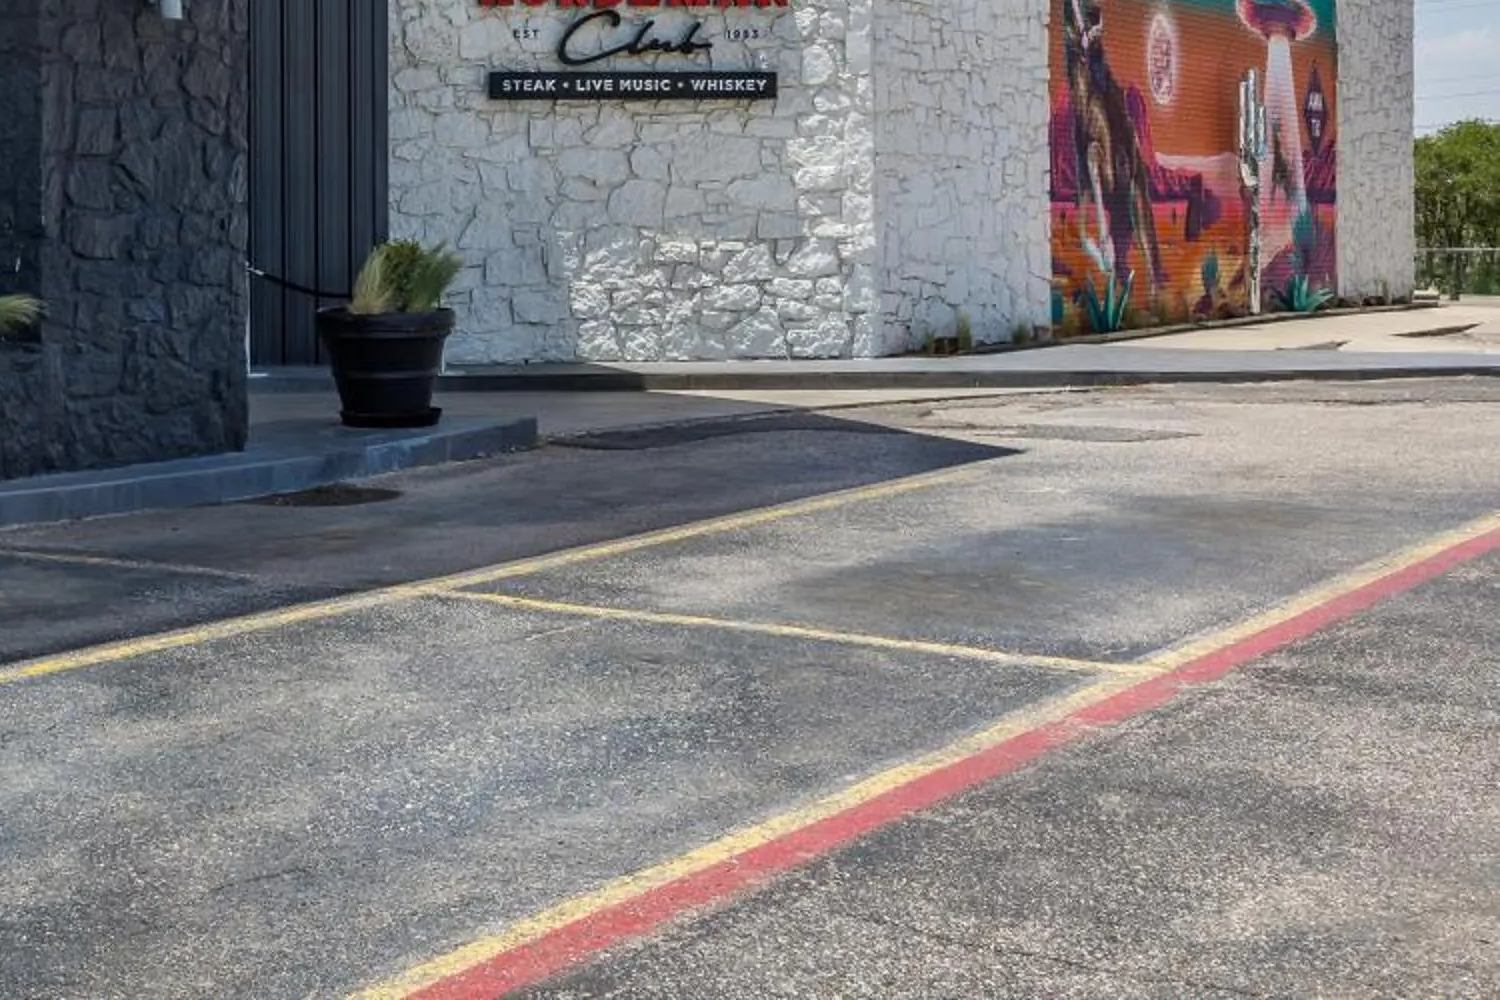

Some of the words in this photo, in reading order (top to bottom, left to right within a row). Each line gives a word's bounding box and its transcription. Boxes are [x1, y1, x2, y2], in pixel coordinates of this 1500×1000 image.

[512, 28, 540, 39] EST
[557, 9, 714, 66] Club
[502, 79, 557, 92] STEAK
[575, 79, 614, 92] LIVE
[619, 79, 672, 92] MUSIC
[691, 79, 768, 92] WHISKEY
